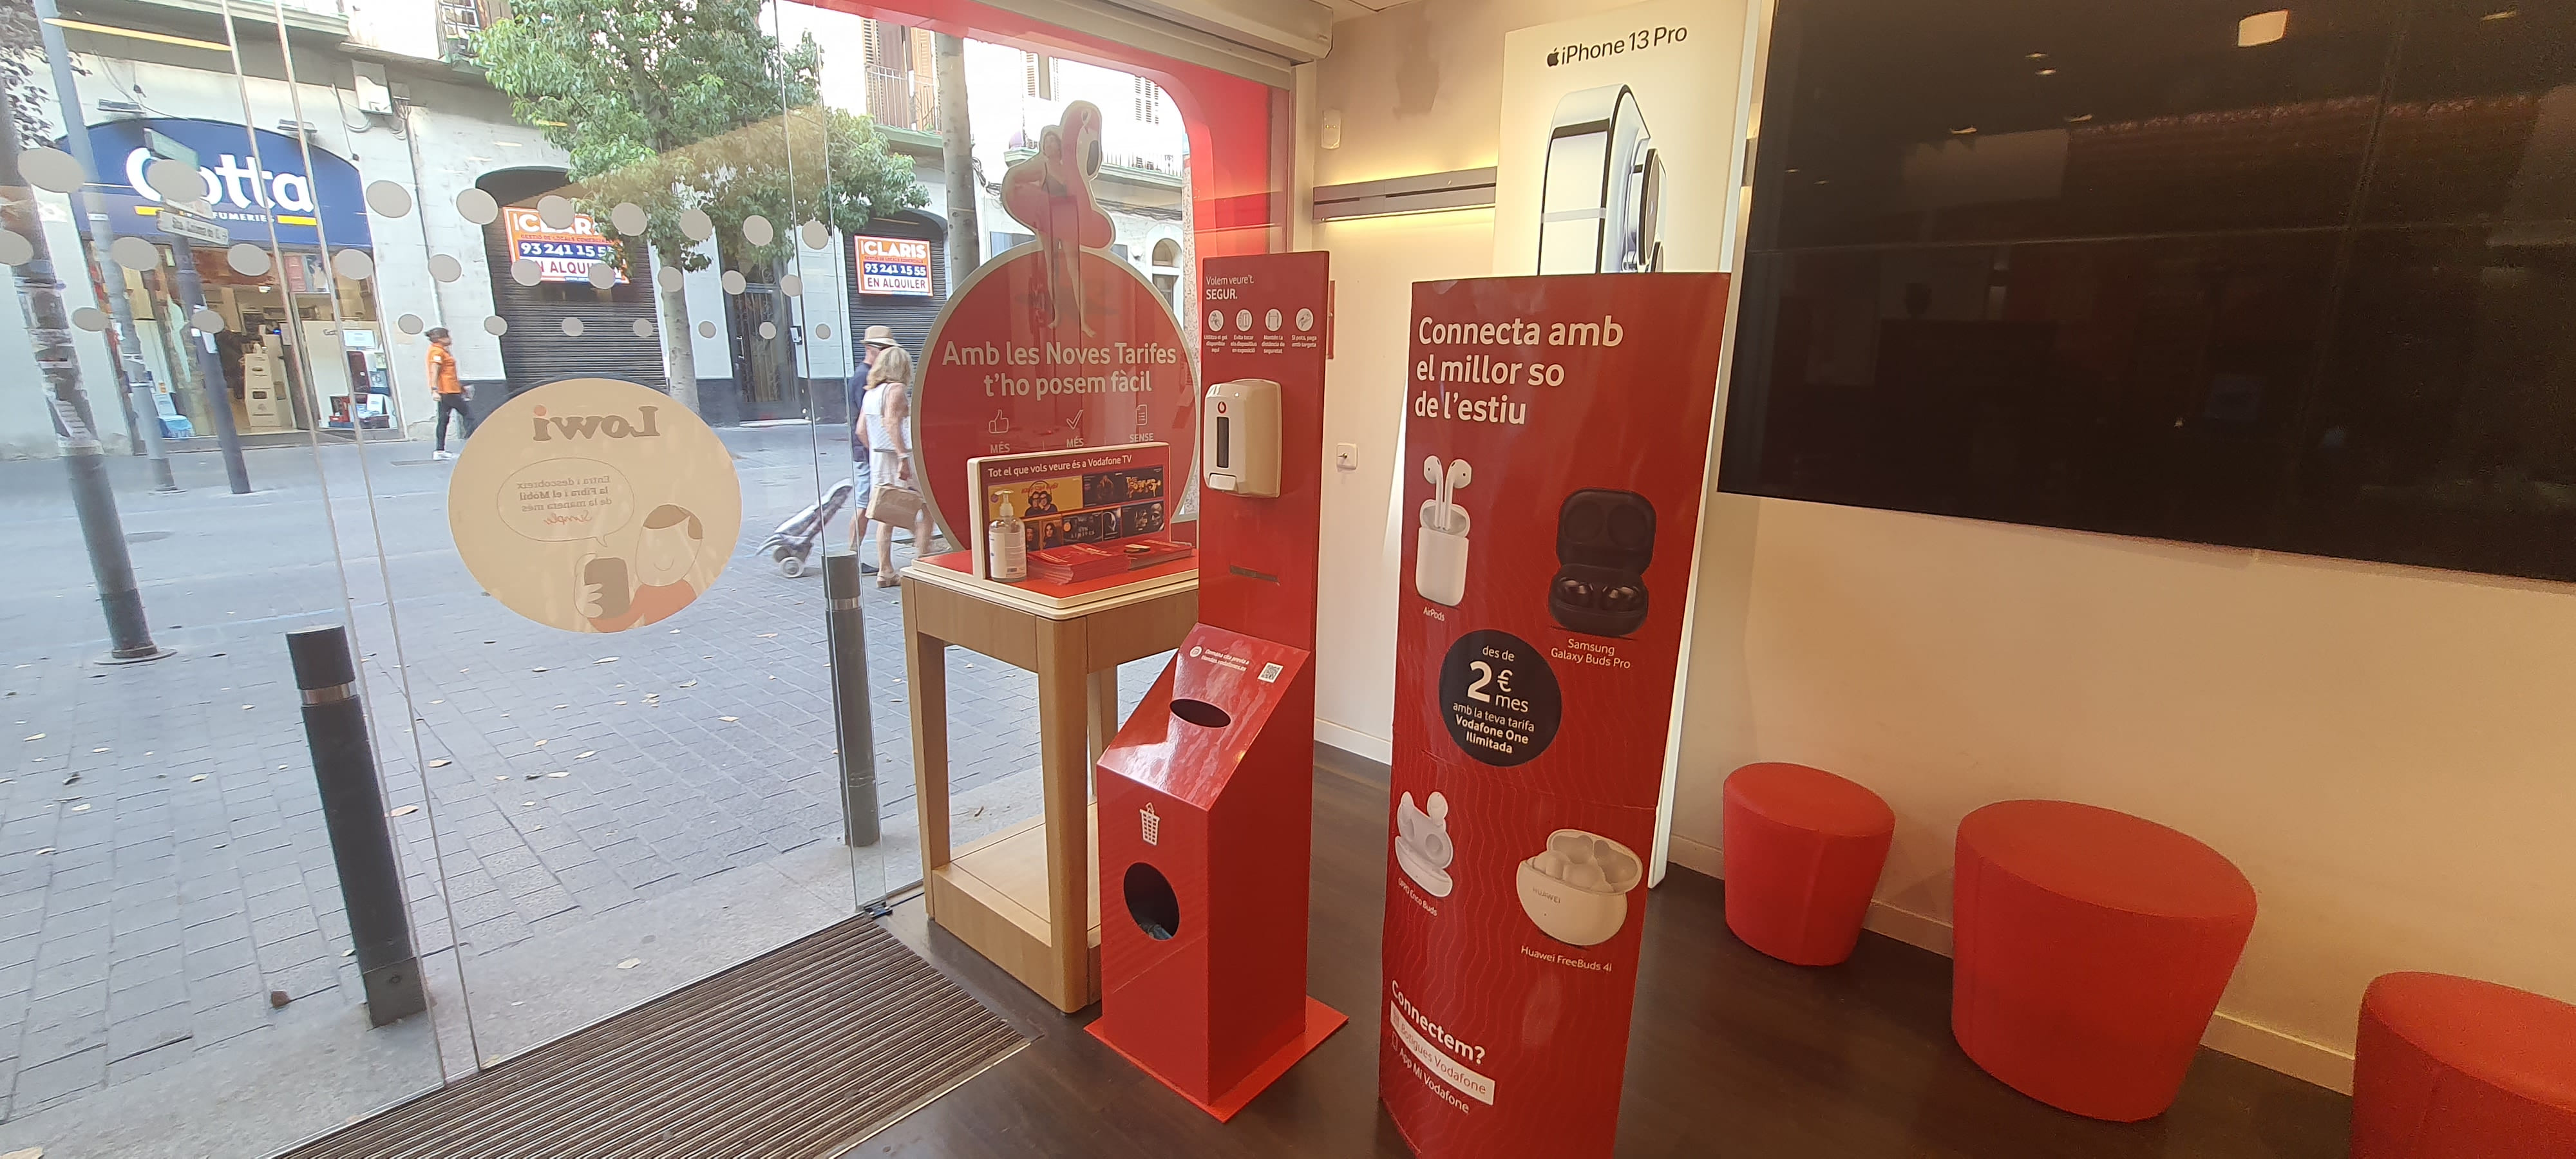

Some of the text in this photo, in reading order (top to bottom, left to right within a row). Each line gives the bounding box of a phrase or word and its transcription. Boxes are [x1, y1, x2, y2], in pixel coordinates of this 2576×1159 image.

[1561, 26, 1687, 66] iPhone 13 Pro
[520, 242, 542, 255] 93
[544, 243, 573, 256] 241
[576, 245, 596, 258] 15
[865, 263, 927, 276] 93 241 15 55
[1206, 276, 1228, 285] Volem
[867, 278, 926, 288] EN ALQUILER
[1206, 288, 1238, 300] SEGUR.
[1418, 315, 1624, 346] Connecta amb
[942, 341, 1177, 366] Amb les Noves Tarifes
[1416, 355, 1566, 387] el millor so
[1036, 376, 1106, 401] posem
[1111, 370, 1152, 393] fàcil
[1414, 391, 1439, 419] de
[990, 441, 1010, 454] MÉS
[1066, 437, 1084, 448] MÉS
[1130, 433, 1153, 442] SENSE
[988, 468, 1002, 478] Tot
[1003, 467, 1012, 476] el
[1014, 466, 1029, 477] que
[1030, 463, 1048, 473] vols
[1048, 462, 1070, 472] veure
[1072, 459, 1081, 469] és
[1088, 457, 1121, 467] Vodafone
[1122, 455, 1132, 464] TV
[1423, 607, 1445, 622] AirPods
[1482, 645, 1515, 661] des de
[1551, 647, 1631, 670] Galaxy Buds Pro
[1567, 638, 1615, 656] Samsung
[1467, 661, 1513, 702] 2 €
[1495, 695, 1529, 713] mes
[1452, 701, 1535, 733] amb la teva tarifa
[1455, 714, 1529, 744] Vodafone One
[1533, 887, 1561, 903] HUAWEI
[1423, 900, 1437, 916] Buds
[1520, 945, 1555, 962] Huawei
[1557, 955, 1601, 971] FreeBuds
[1392, 979, 1486, 1065] Connectem?
[1434, 1055, 1486, 1095] Vodafone
[1424, 1072, 1470, 1114] Vodafone
